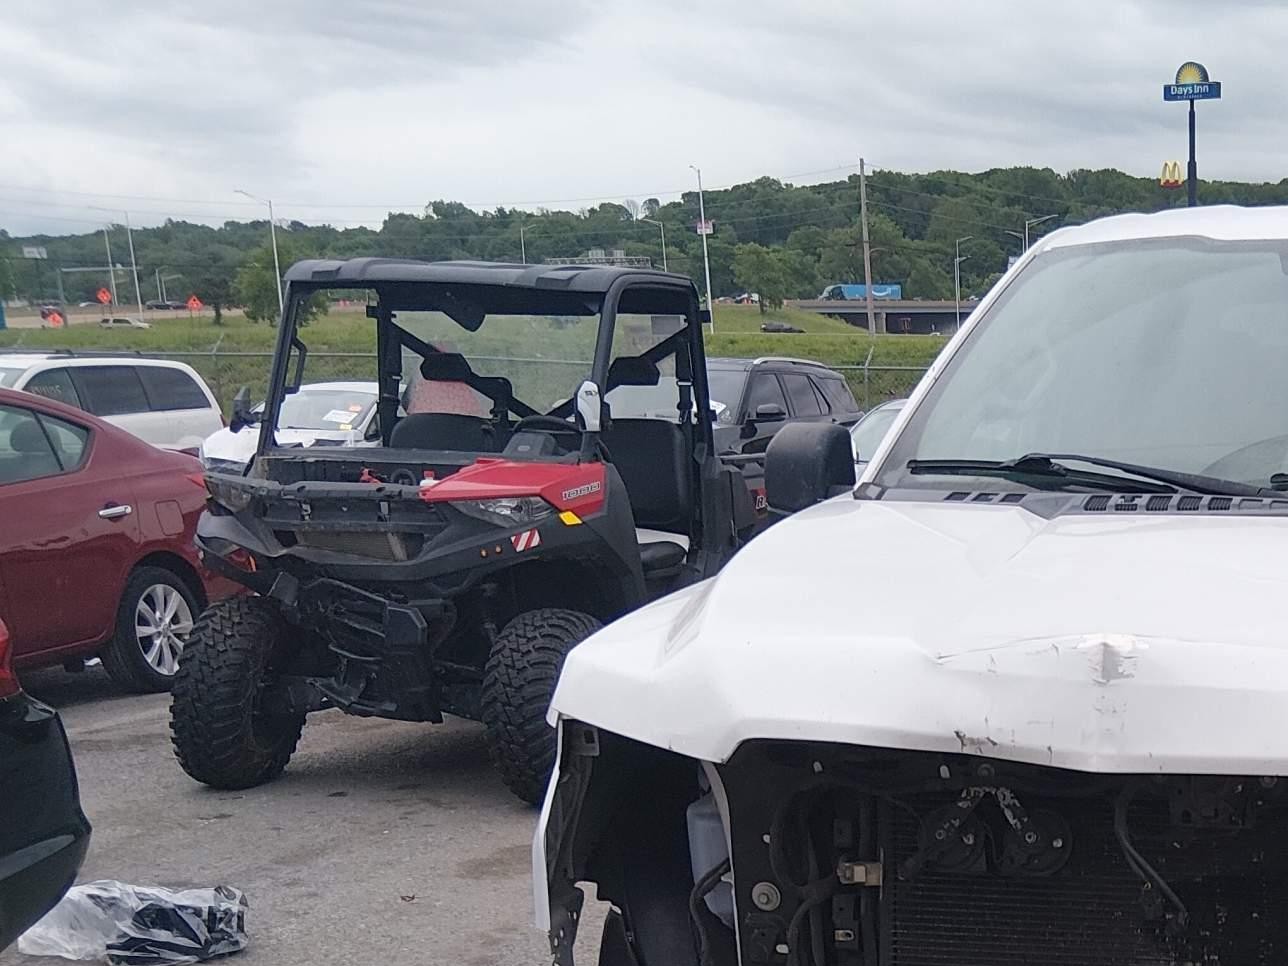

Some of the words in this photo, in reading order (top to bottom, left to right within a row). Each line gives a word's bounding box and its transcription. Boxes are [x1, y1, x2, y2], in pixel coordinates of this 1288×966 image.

[1170, 85, 1193, 96] Days
[1194, 84, 1209, 94] Inn
[562, 481, 601, 501] 1000
